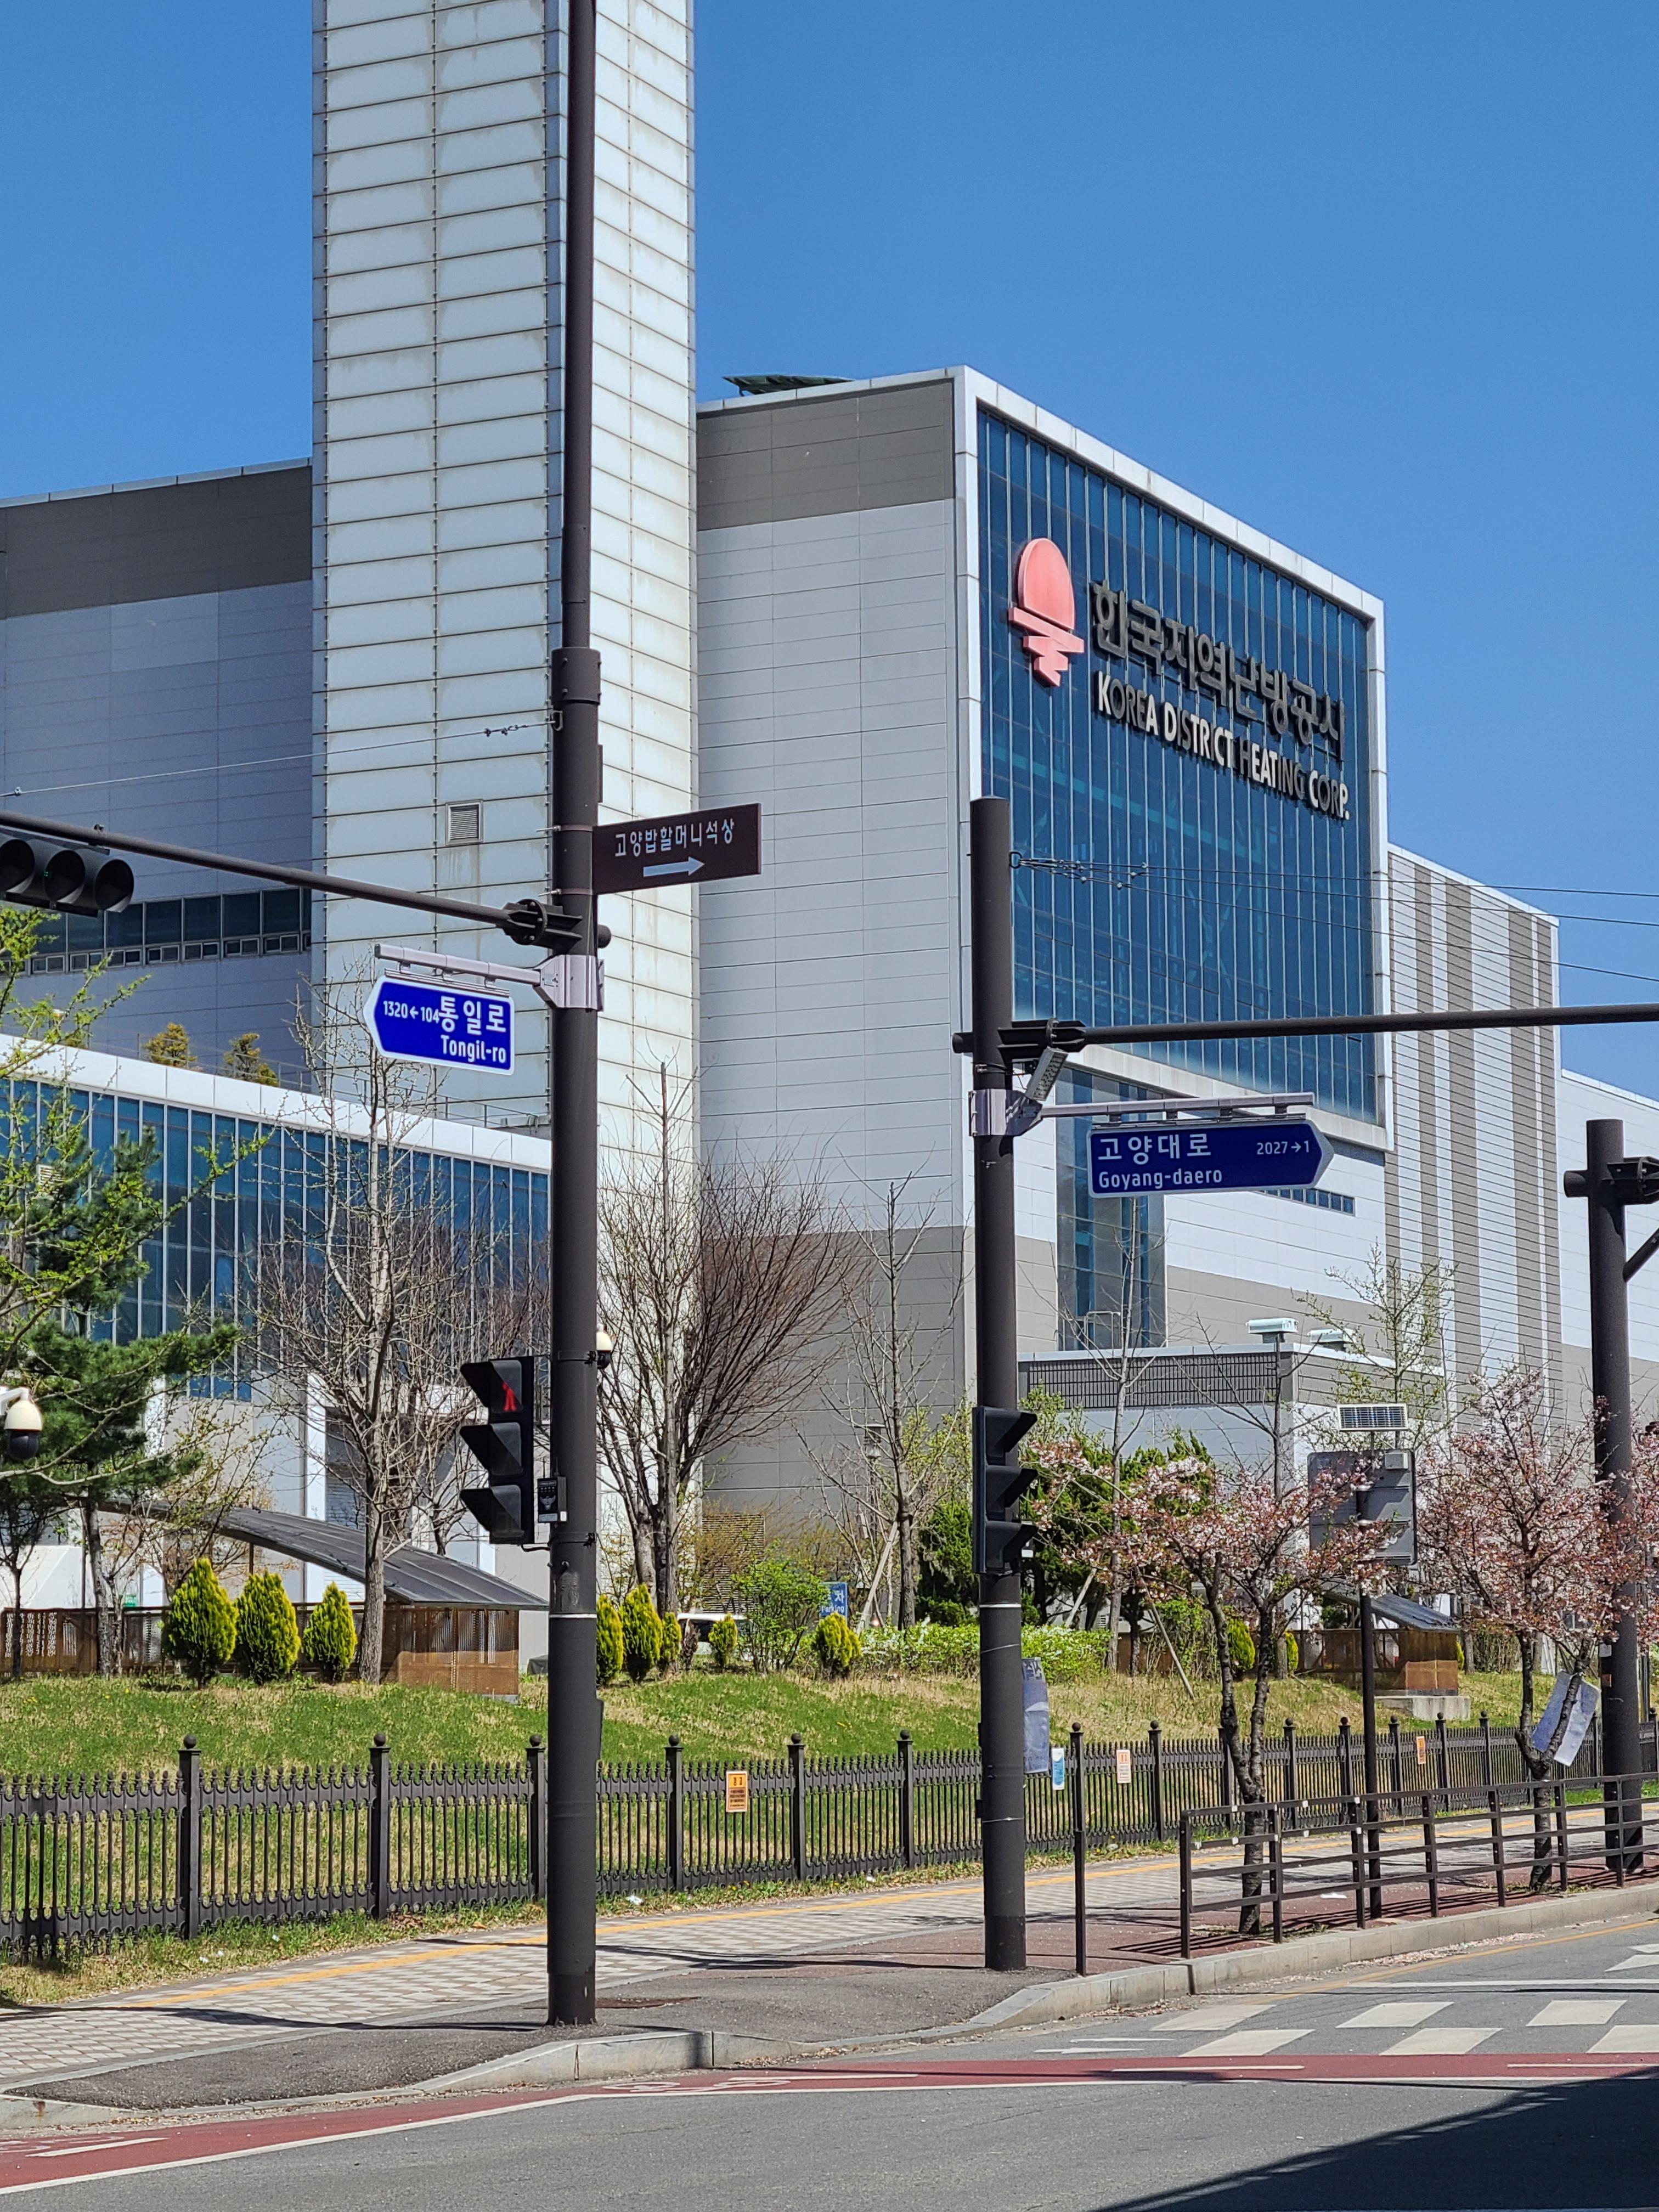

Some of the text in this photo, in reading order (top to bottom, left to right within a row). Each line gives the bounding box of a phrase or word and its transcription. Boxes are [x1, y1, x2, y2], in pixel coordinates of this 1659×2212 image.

[1092, 579, 1345, 761] 한국지역난방공사
[1098, 670, 1350, 820] KOREA DISTRICT HEATING CORP.
[614, 818, 735, 857] 고양밥할머니석상
[439, 996, 506, 1035] 통일로
[441, 1035, 506, 1063] Tongil-ro
[1098, 1133, 1211, 1165] 고양대로
[1099, 1169, 1222, 1189] Goyang-daero
